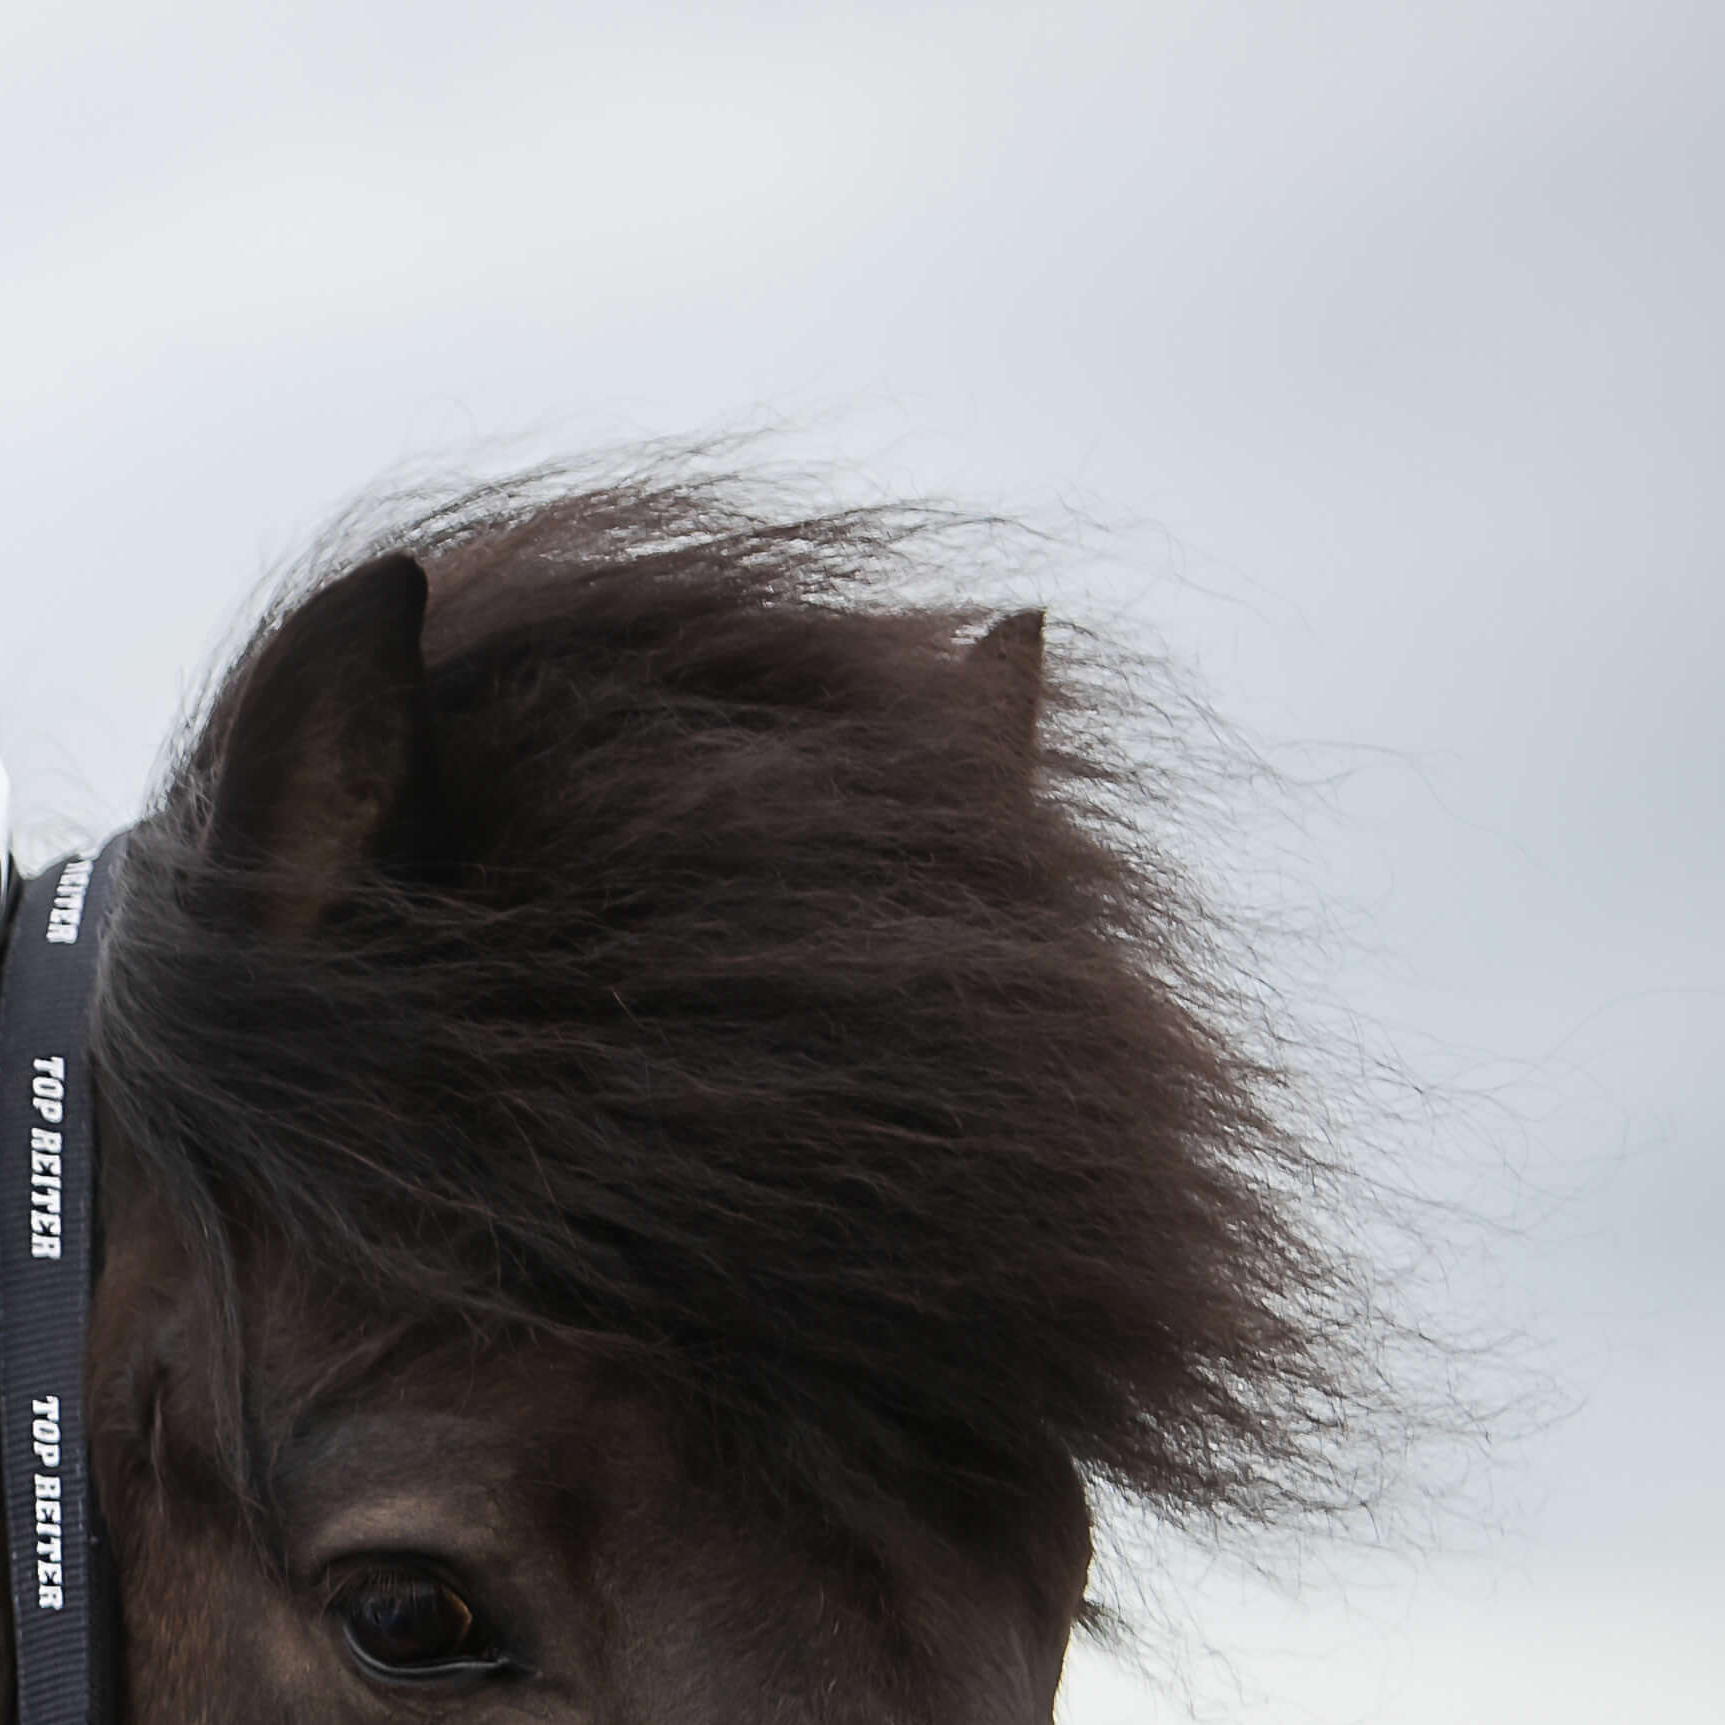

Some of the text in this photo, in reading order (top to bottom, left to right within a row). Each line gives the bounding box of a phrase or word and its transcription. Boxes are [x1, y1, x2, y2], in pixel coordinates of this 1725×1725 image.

[30, 1056, 65, 1260] TOP REITER
[32, 1395, 63, 1611] TOP REITER
